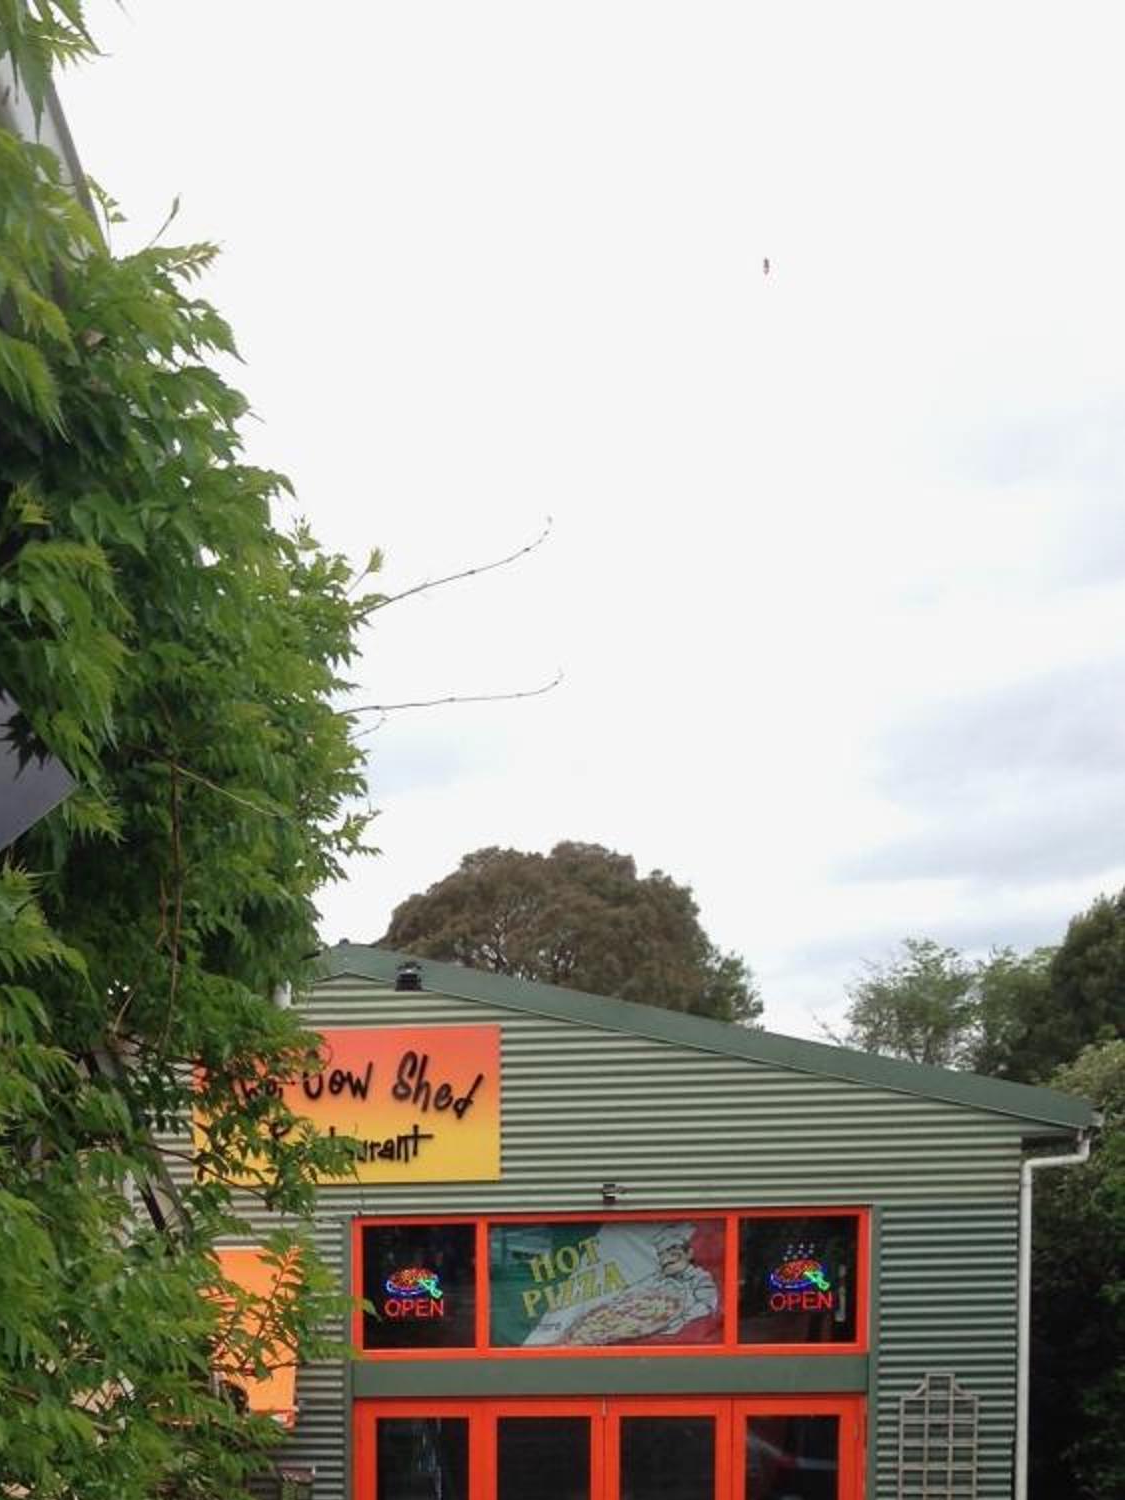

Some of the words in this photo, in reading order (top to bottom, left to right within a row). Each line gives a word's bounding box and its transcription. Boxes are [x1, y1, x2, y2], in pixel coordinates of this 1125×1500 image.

[392, 1050, 484, 1120] Shed
[530, 1237, 600, 1283] HOT
[383, 1300, 444, 1317] OPEN
[522, 1260, 629, 1318] PIZZA
[770, 1292, 833, 1311] OPEN
